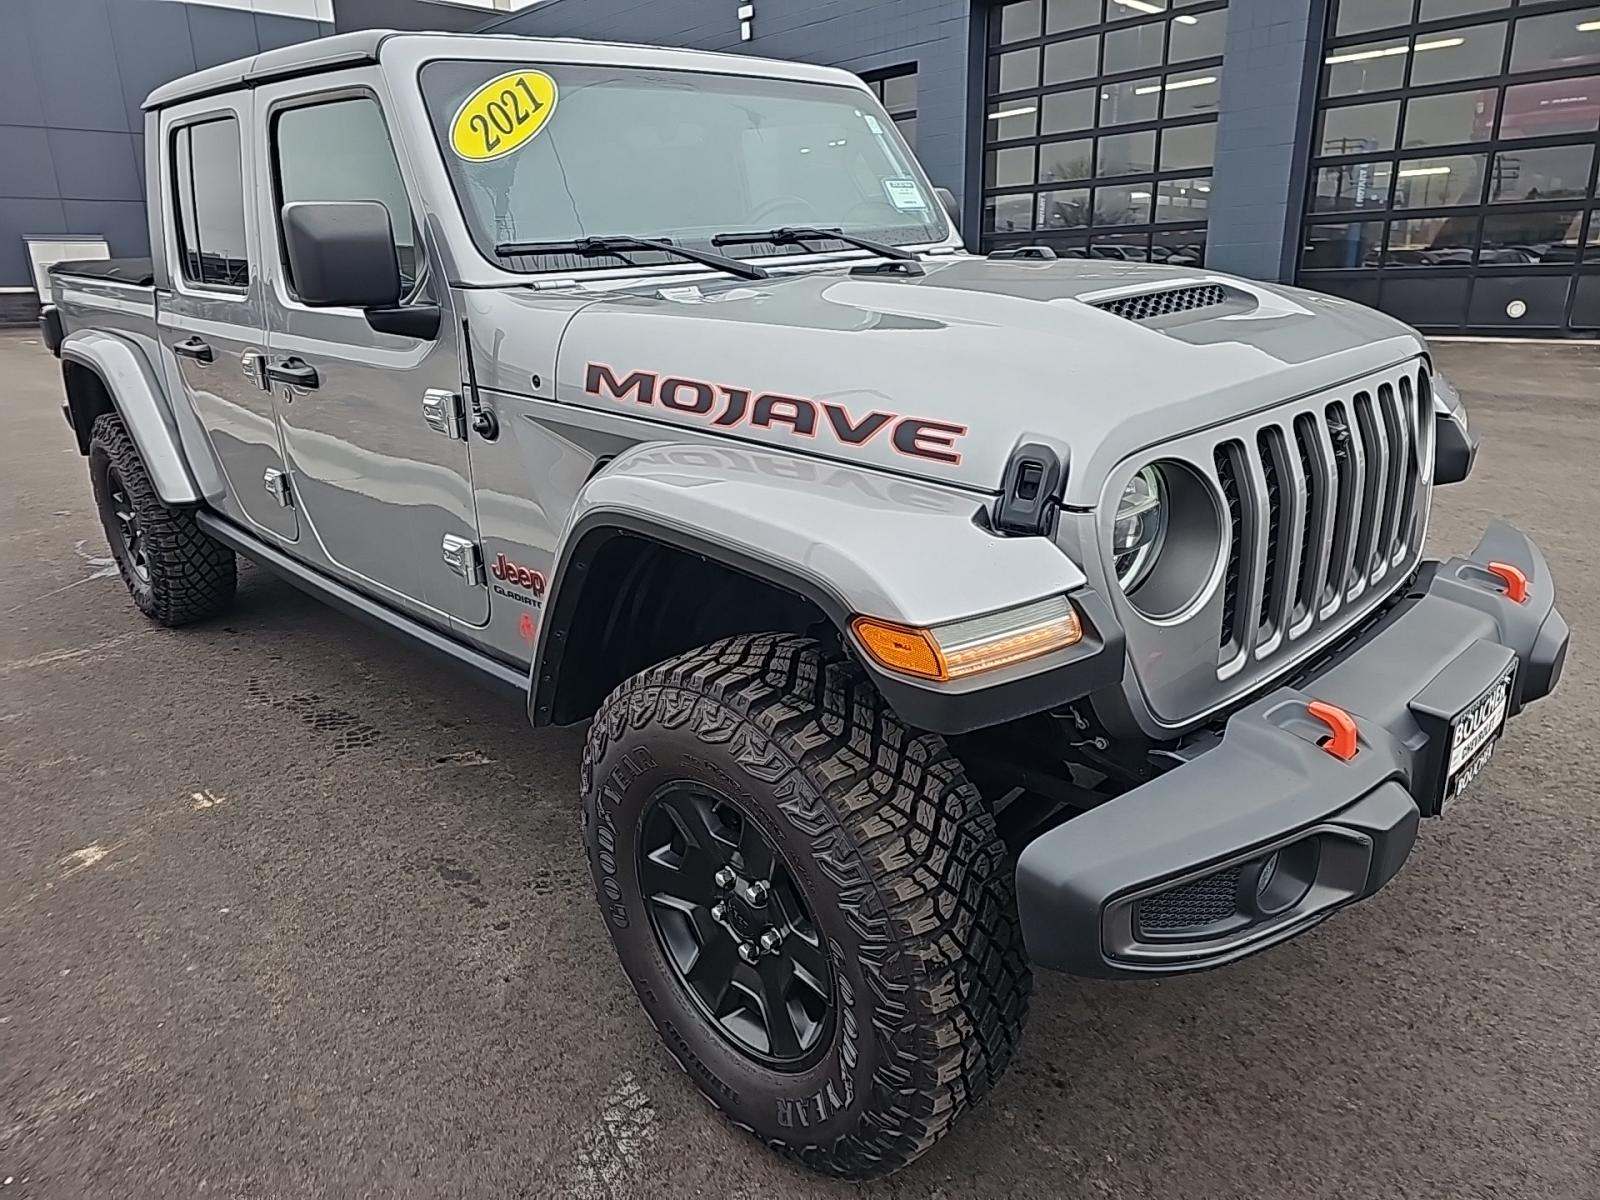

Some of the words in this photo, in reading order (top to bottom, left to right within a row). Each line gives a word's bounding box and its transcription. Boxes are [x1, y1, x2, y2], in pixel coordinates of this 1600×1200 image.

[470, 78, 544, 152] 2021
[584, 361, 968, 465] MOJAVE
[491, 552, 547, 598] Jeep
